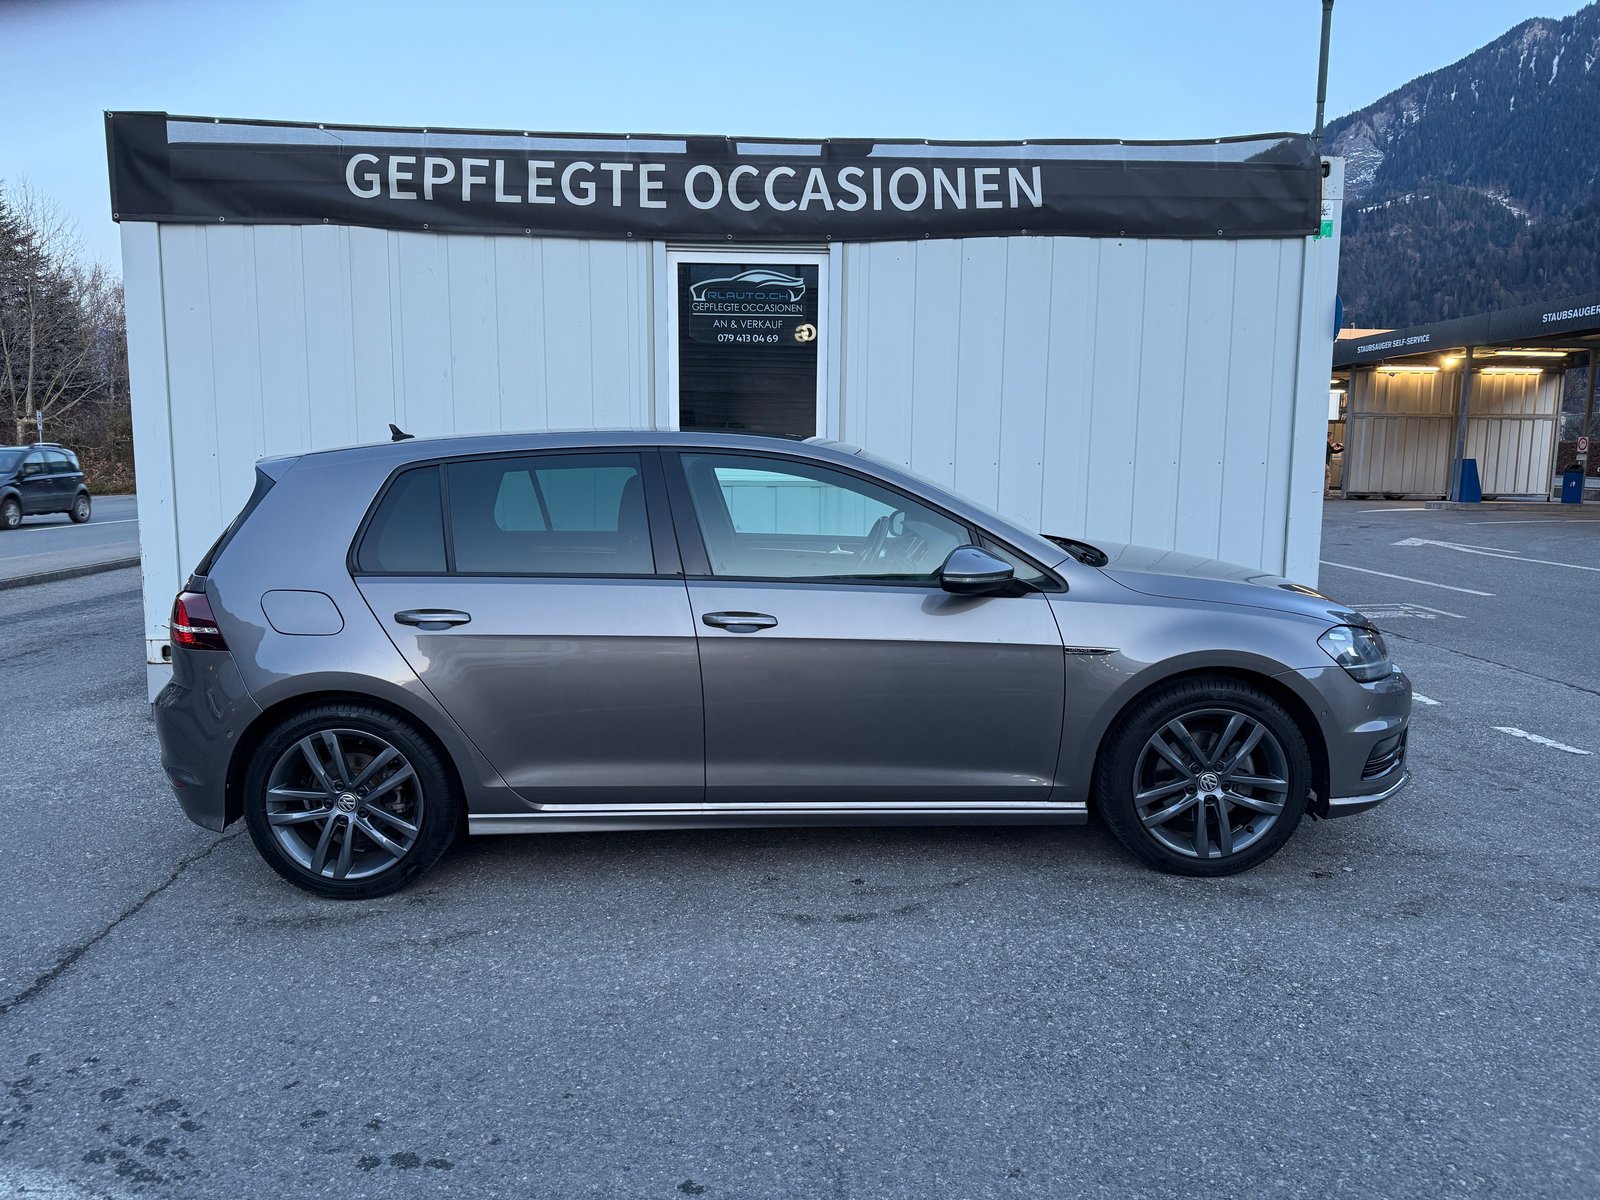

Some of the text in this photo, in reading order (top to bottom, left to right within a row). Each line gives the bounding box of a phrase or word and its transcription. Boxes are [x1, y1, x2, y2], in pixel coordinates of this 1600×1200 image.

[345, 153, 1043, 211] GEPFLEGTE OCCASIONEN
[707, 291, 788, 300] RLAUTO.CH
[692, 302, 803, 313] GEPFLEGTE OCCASIONEN
[713, 320, 783, 329] AN & VERKAUF
[717, 333, 779, 343] 079 413 04 69
[1357, 334, 1430, 353] STAUBSAUGER SELF-SERVICE
